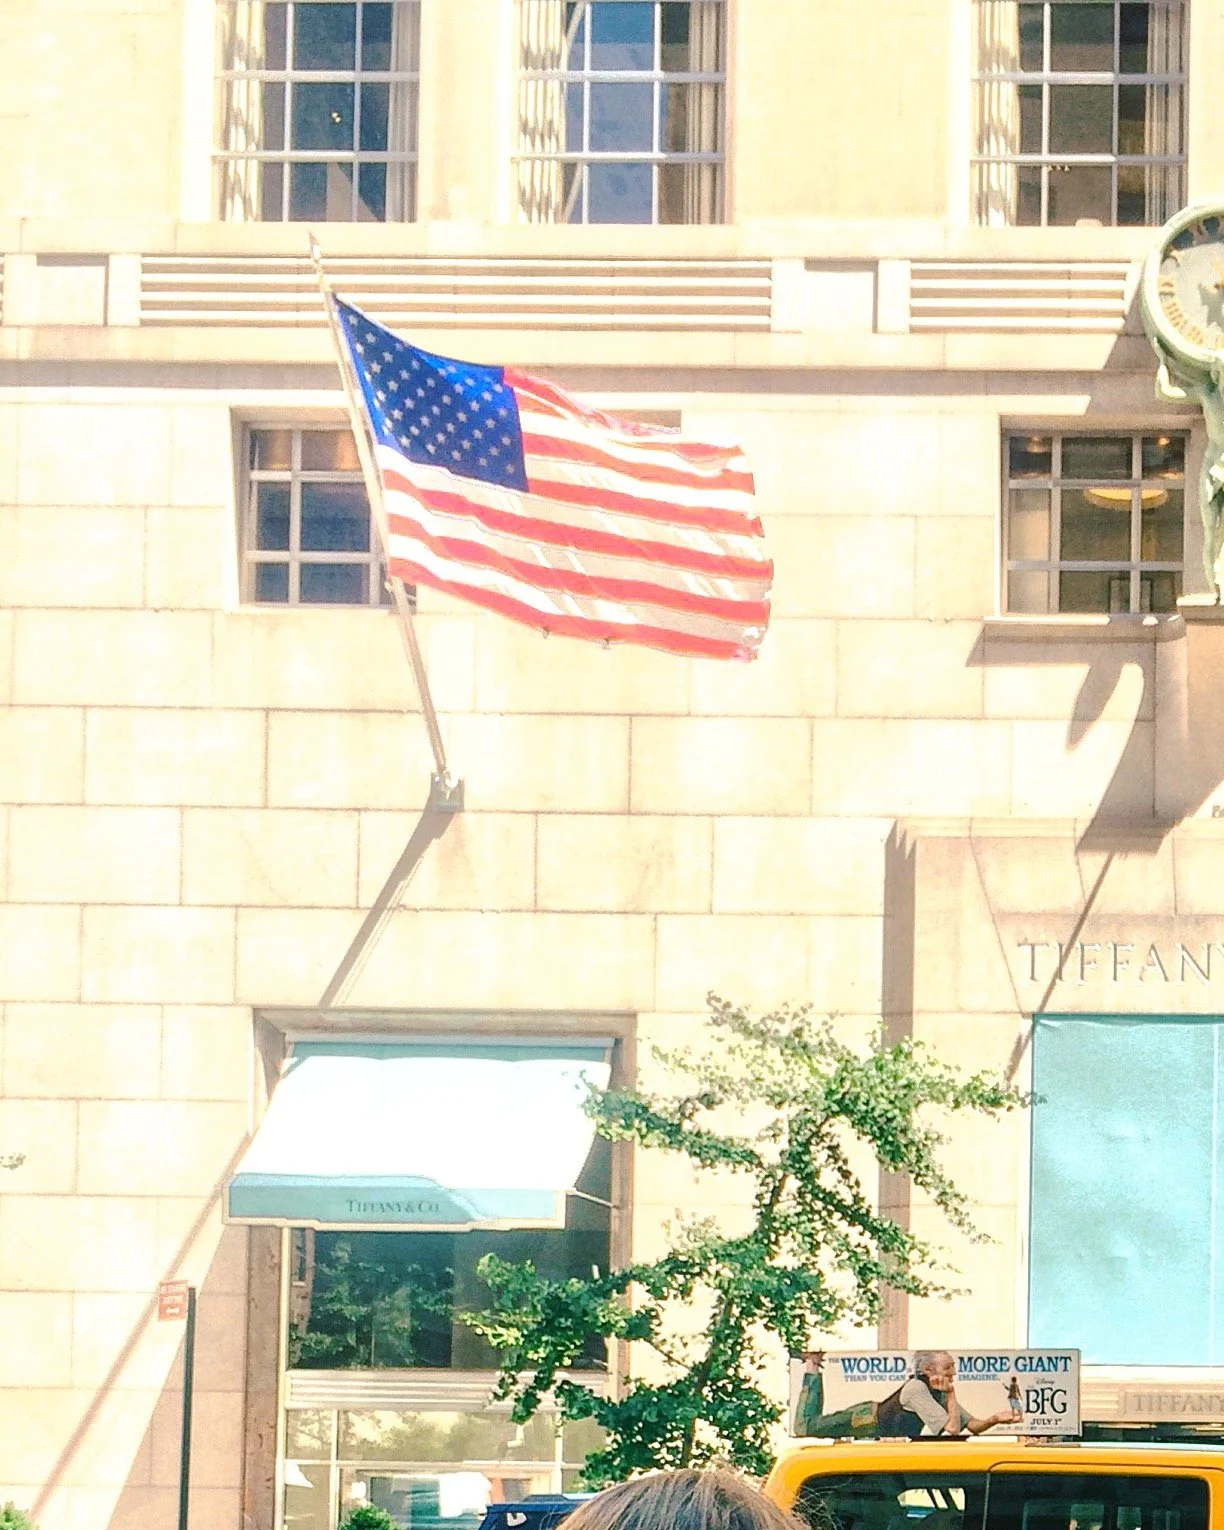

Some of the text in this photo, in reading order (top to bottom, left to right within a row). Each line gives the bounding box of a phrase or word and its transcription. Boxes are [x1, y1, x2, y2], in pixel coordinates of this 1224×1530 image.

[840, 1356, 906, 1373] WORLD
[958, 1356, 1010, 1373] MORE
[1014, 1356, 1072, 1373] GIANT
[869, 1374, 887, 1382] YOU
[889, 1374, 906, 1382] CAN
[1025, 1386, 1067, 1415] BFG
[1030, 1418, 1053, 1426] JULY
